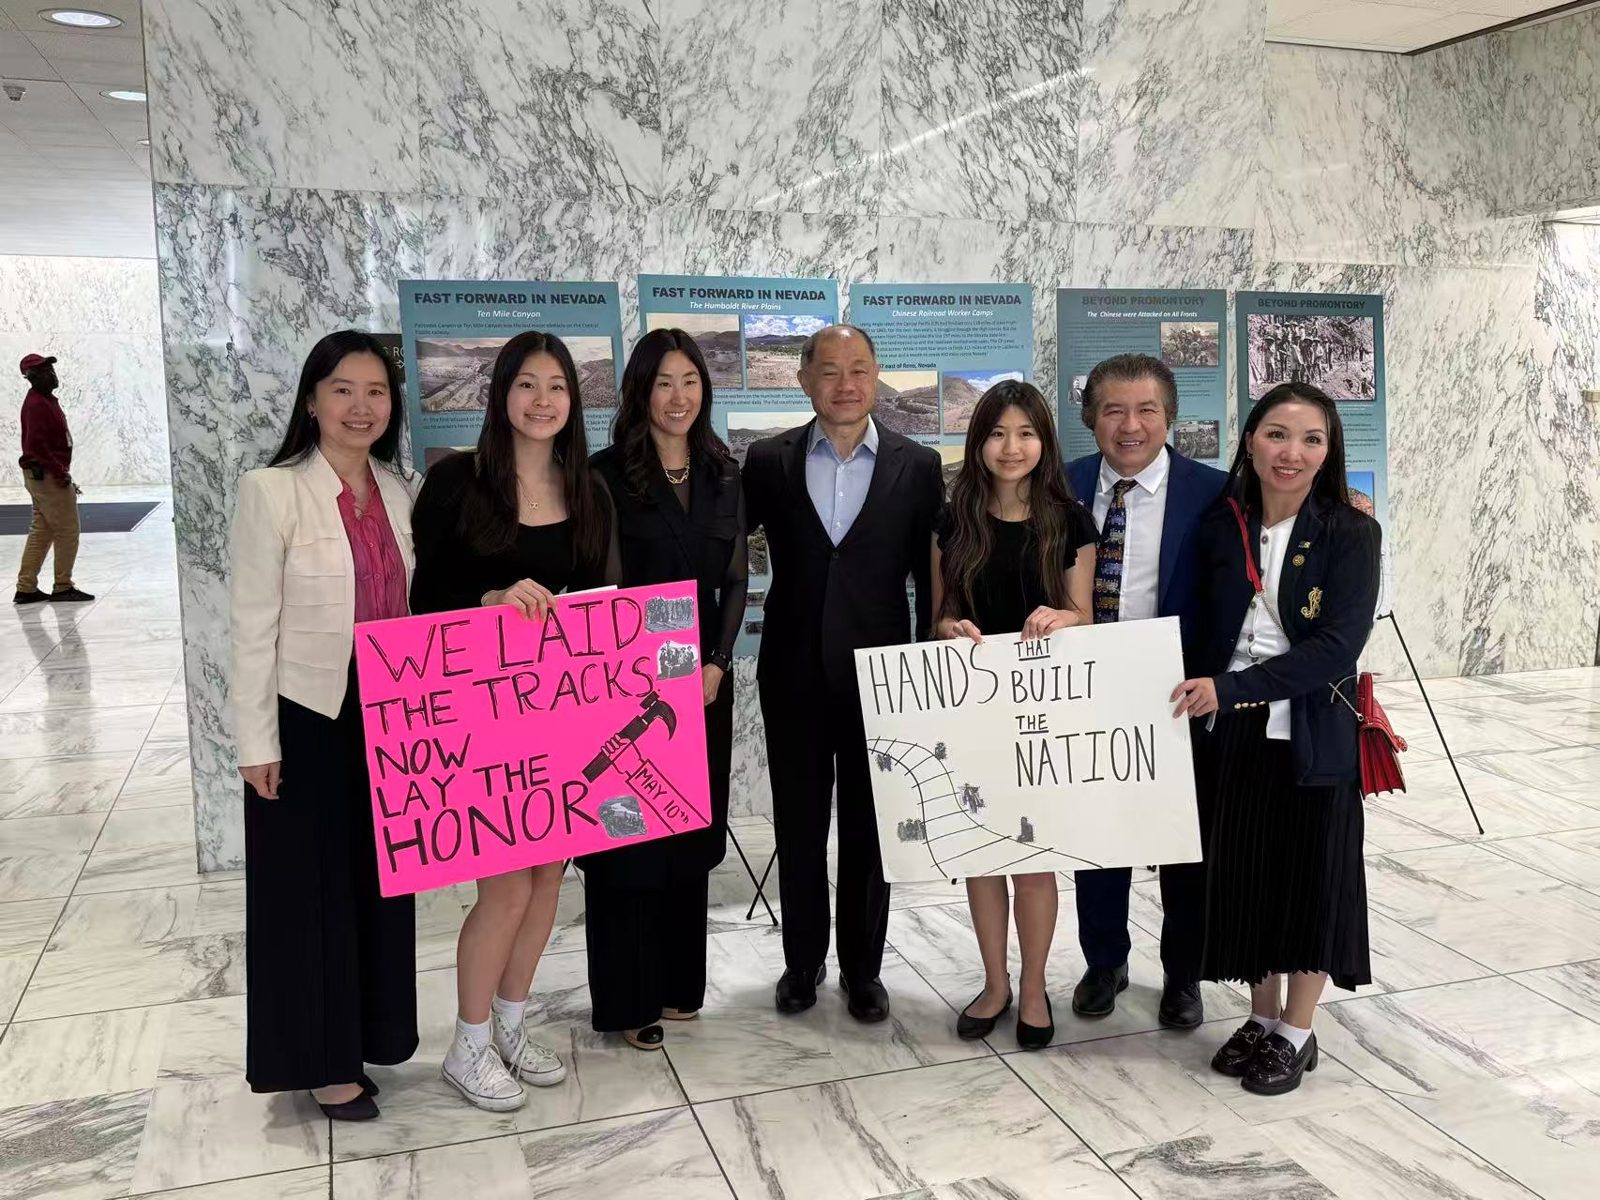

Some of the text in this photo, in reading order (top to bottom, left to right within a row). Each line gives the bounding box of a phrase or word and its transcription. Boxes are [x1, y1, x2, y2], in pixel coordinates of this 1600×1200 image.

[414, 292, 607, 305] FAST FORWARD IN NEVADA
[652, 287, 826, 300] FAST FORWARD IN NEVADA
[704, 302, 740, 310] Humboldt
[760, 303, 782, 311] Plains
[863, 295, 1022, 305] FAST FORWARD IN NEVADA
[1081, 296, 1206, 306] BEYOND PROMONTORY
[1258, 299, 1366, 309] BEYOND PROMONTORY
[476, 310, 541, 319] Ten Mile Canyon
[367, 597, 643, 683] WE LAID
[1013, 637, 1051, 658] THAT
[868, 641, 1000, 715] HANDS
[1011, 660, 1096, 704] BUILT
[365, 689, 458, 735] THE
[1015, 713, 1048, 731] THE
[375, 733, 471, 779] NOW
[1015, 723, 1156, 788] NATION
[376, 753, 551, 819] LAY THE
[635, 768, 667, 800] MAY
[383, 780, 599, 873] HONOR
